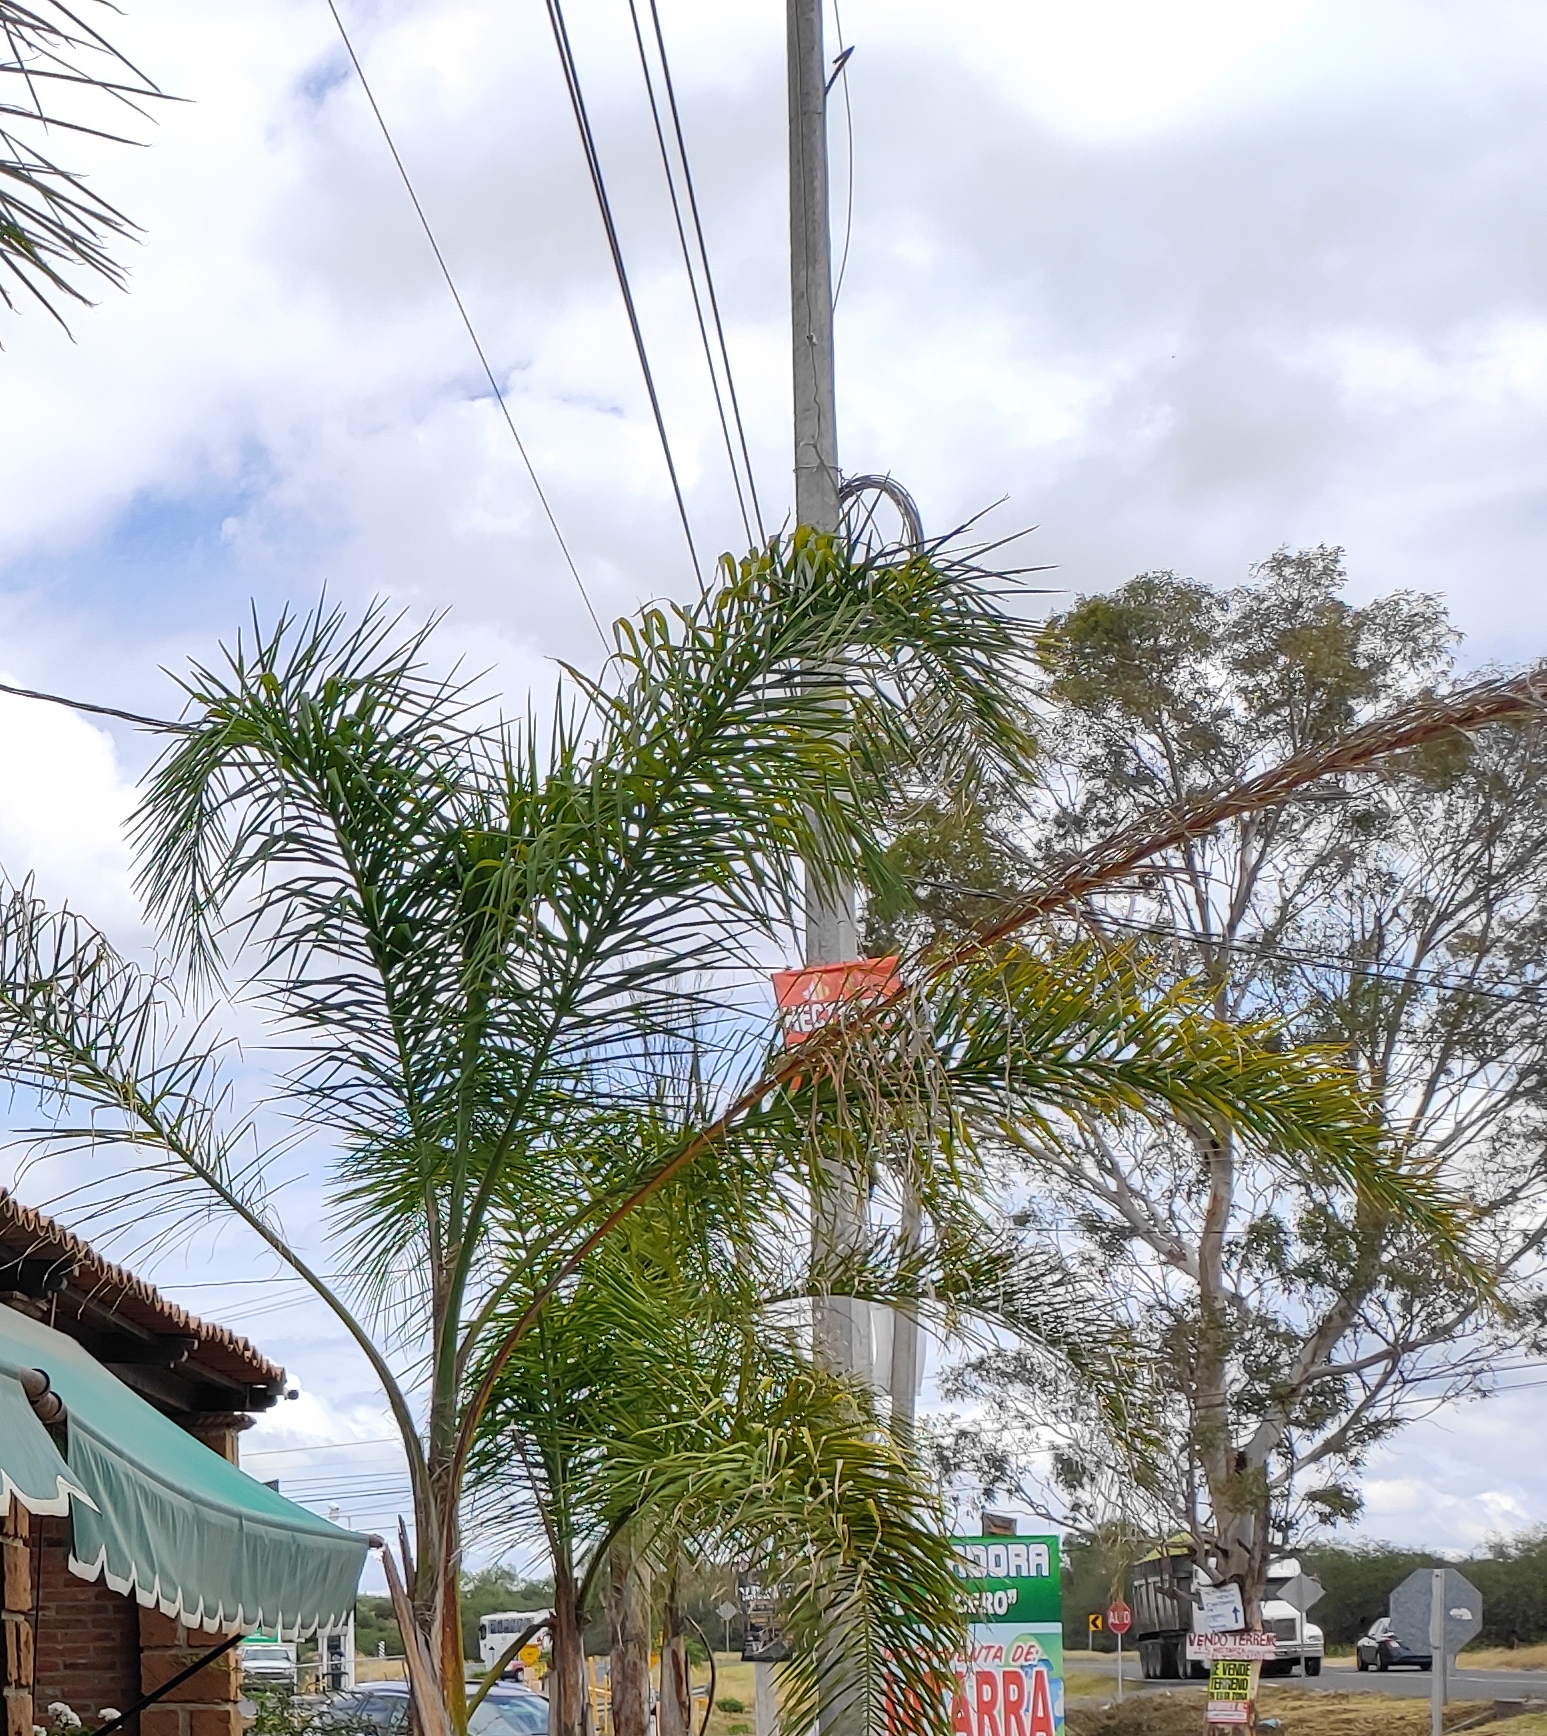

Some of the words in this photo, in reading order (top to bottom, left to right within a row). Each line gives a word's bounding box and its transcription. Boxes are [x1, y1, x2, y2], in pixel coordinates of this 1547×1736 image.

[1108, 1611, 1131, 1624] ALO
[1188, 1633, 1228, 1647] VENDO
[1011, 1644, 1040, 1664] DE:
[1222, 1663, 1251, 1677] VENDE
